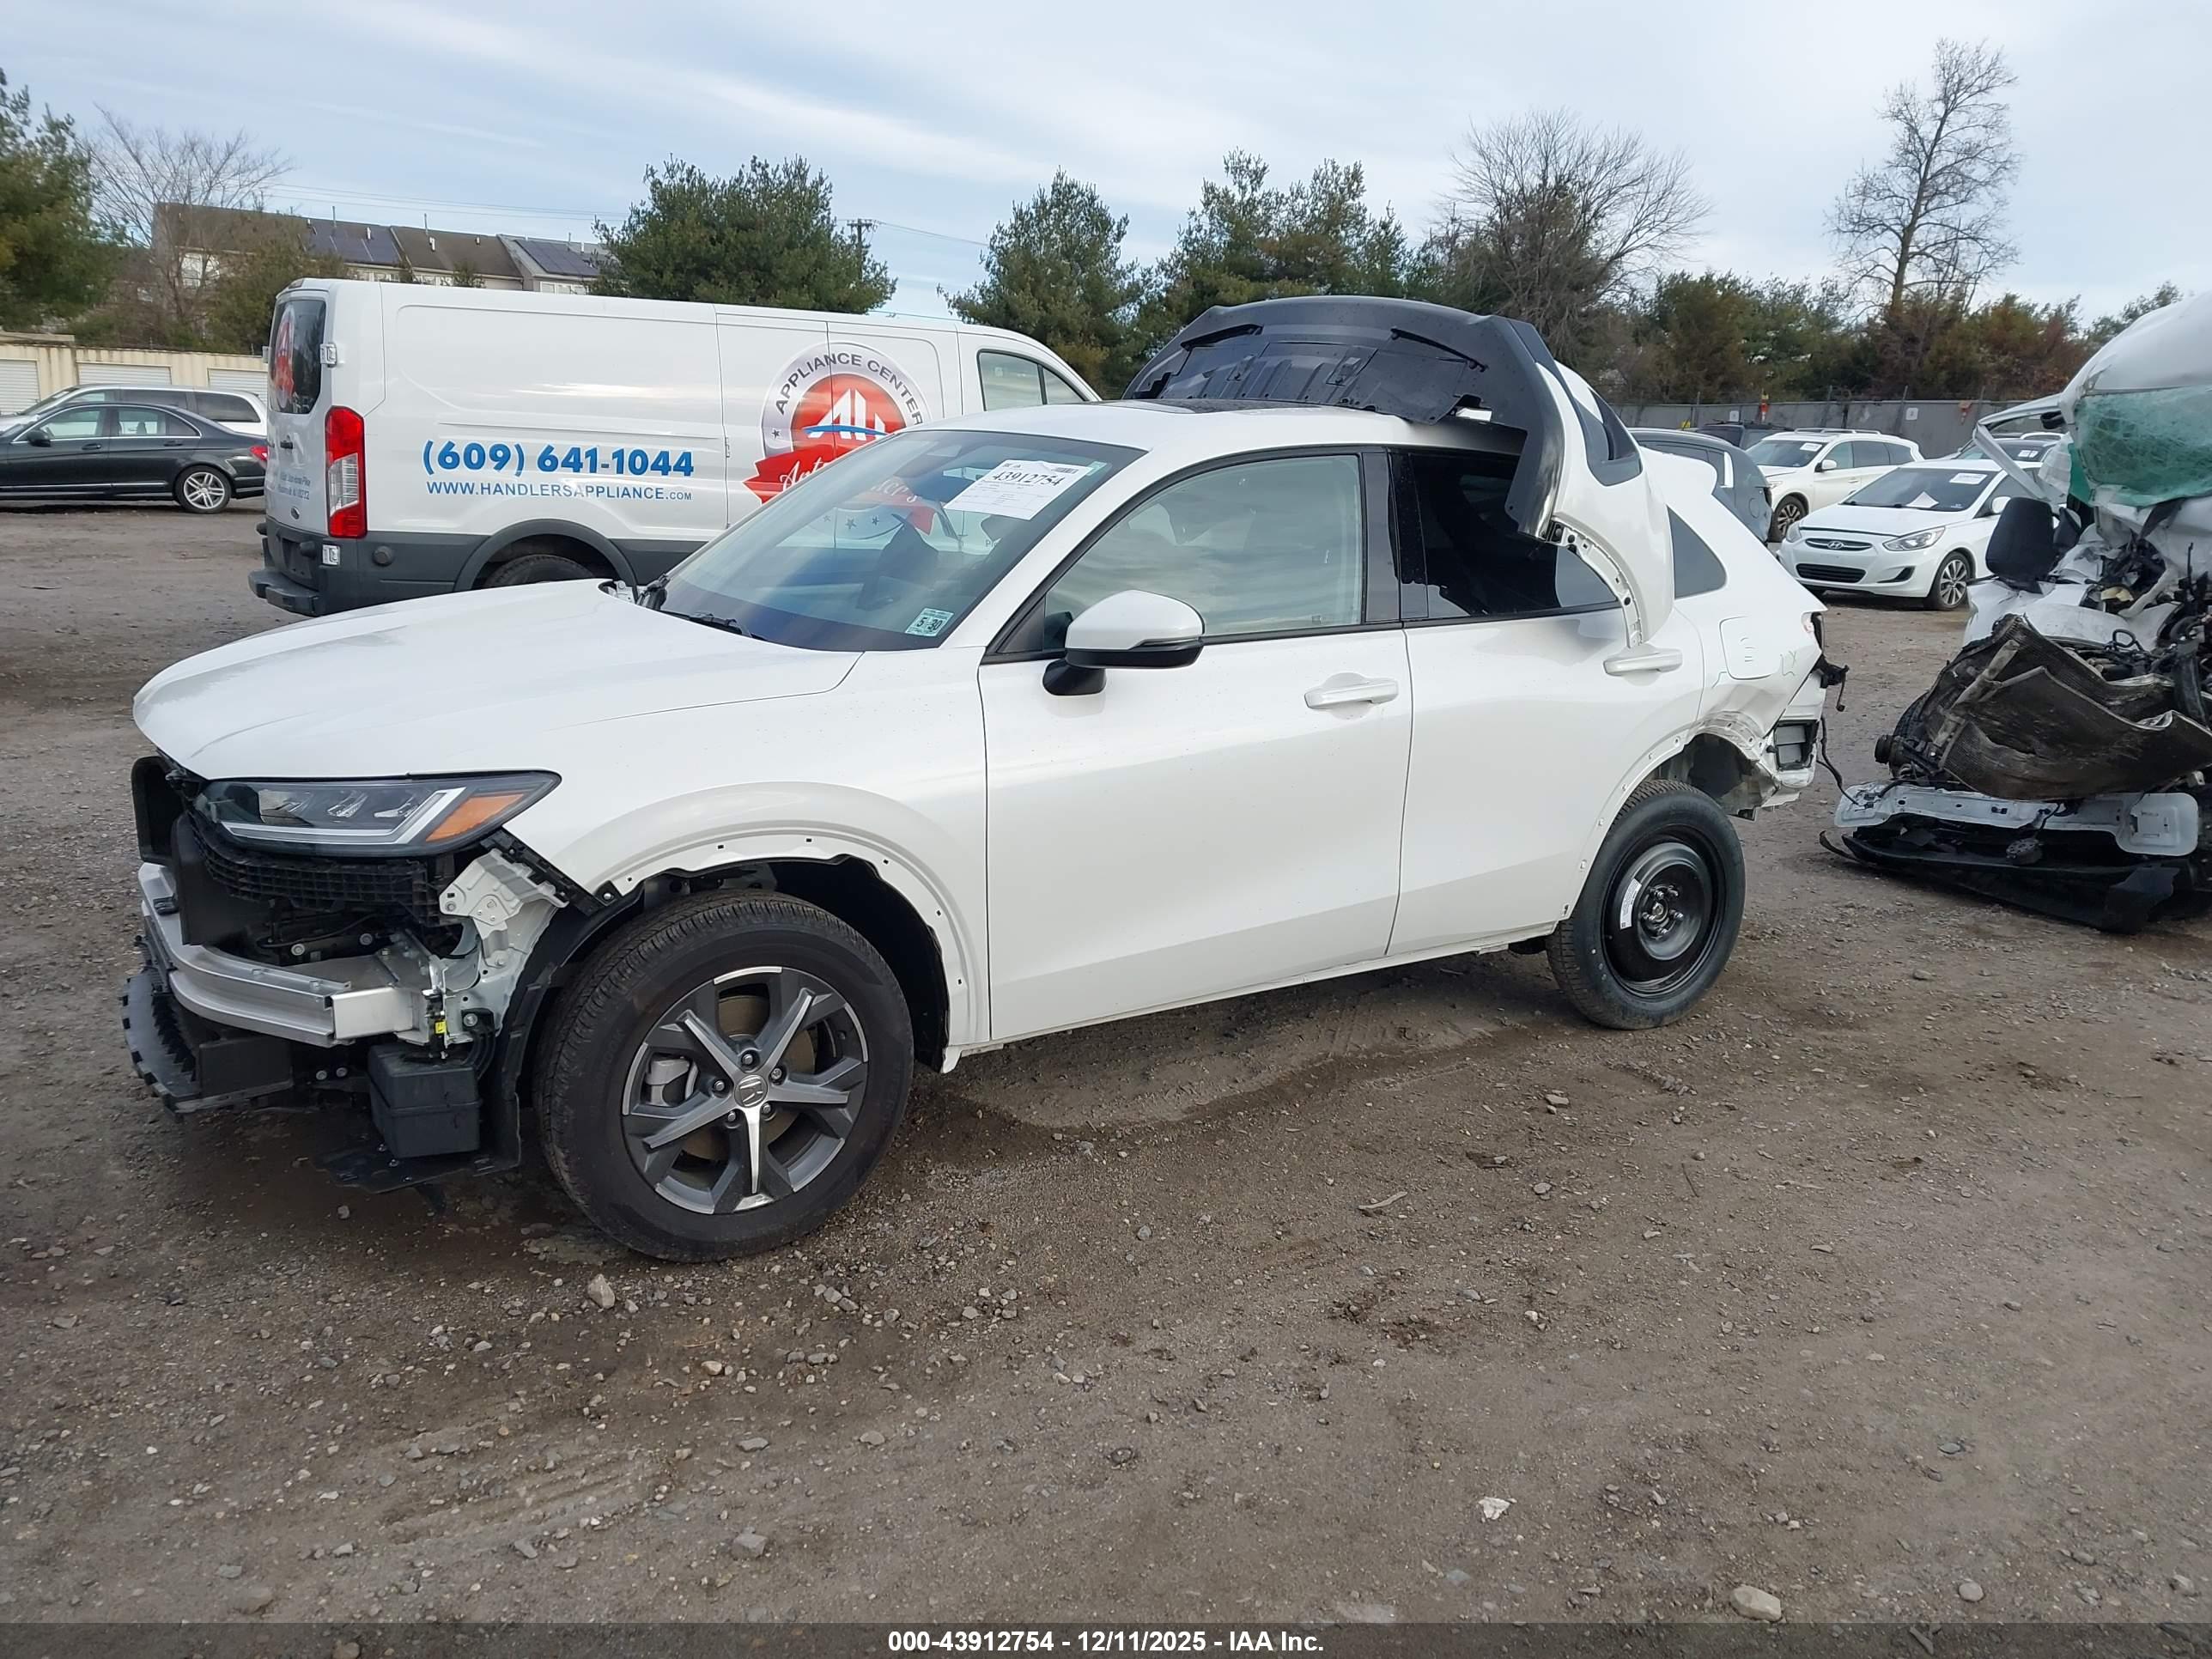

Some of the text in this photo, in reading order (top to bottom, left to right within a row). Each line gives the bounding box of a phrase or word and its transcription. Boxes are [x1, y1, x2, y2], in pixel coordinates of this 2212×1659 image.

[775, 353, 923, 425] APPLIANCE CENTER
[422, 440, 695, 477] (609) 641-1044
[993, 471, 1066, 487] 43912754
